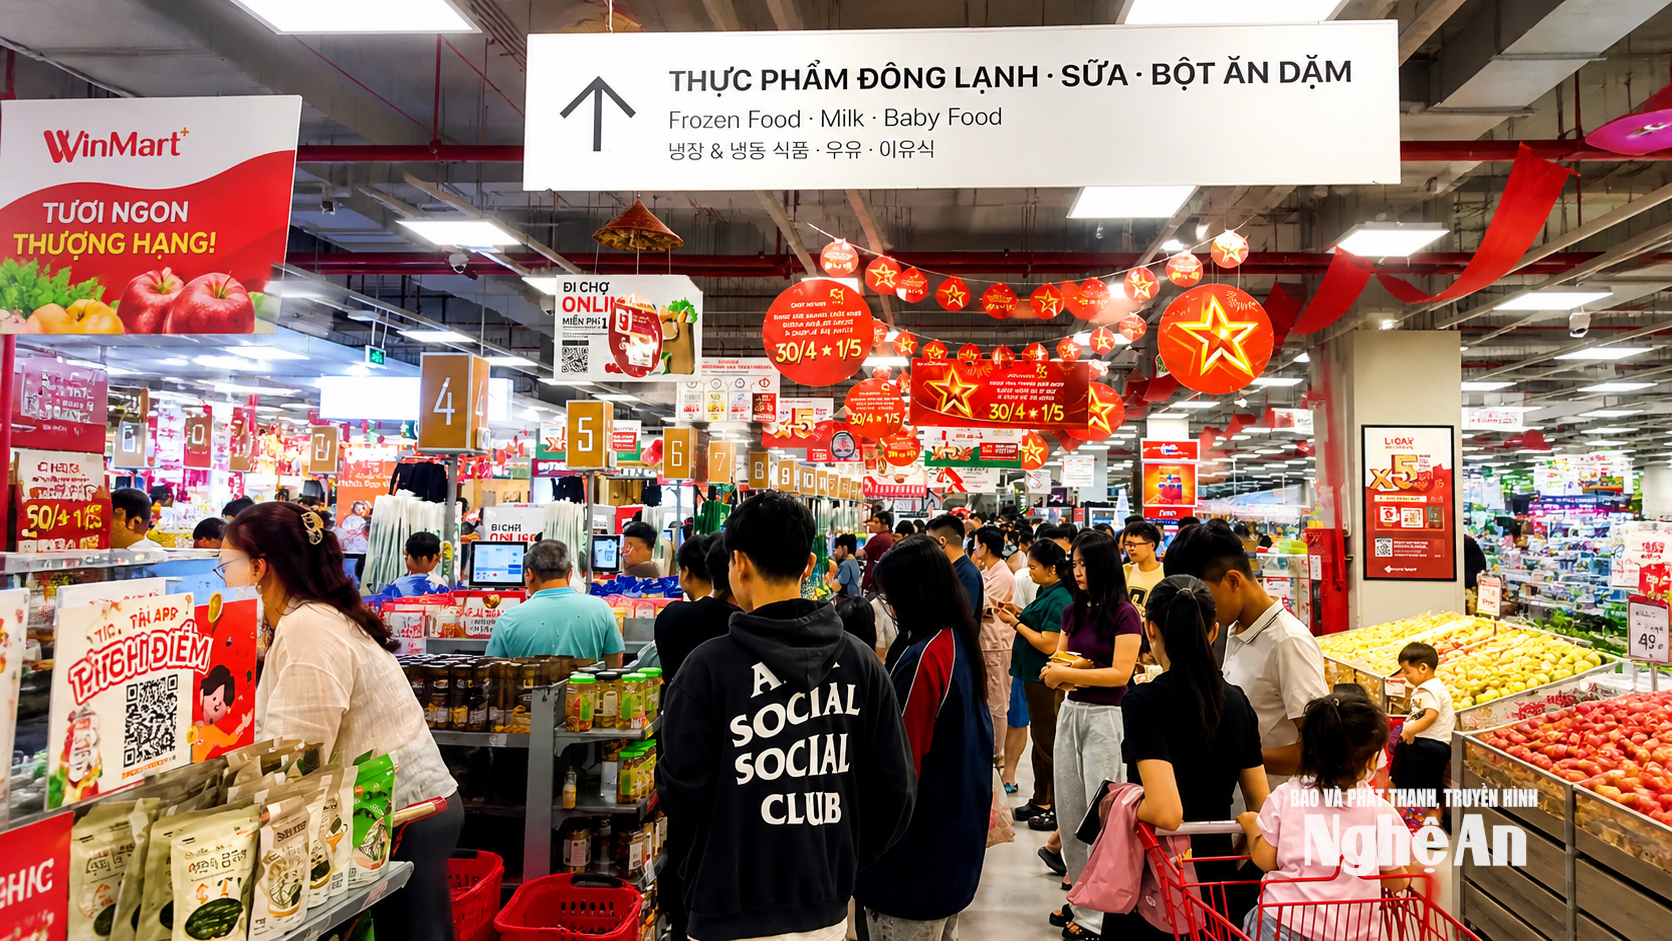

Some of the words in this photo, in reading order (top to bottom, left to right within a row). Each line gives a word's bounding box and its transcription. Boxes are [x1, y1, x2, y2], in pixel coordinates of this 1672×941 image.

[669, 66, 752, 97] THỰC
[761, 59, 848, 90] PHẨM
[857, 62, 946, 90] ĐÔNG
[955, 65, 1038, 94] LẠNH
[1061, 58, 1129, 87] SỮA
[1151, 56, 1216, 91] BỘT
[1224, 55, 1269, 85] ĂN
[1280, 54, 1352, 90] DẶM
[669, 111, 740, 129] Frozen
[749, 109, 801, 129] Food
[821, 109, 864, 127] Milk
[884, 108, 941, 131] Baby
[949, 107, 1002, 126] Food
[669, 142, 704, 161] 냉장
[710, 142, 724, 159] &
[730, 142, 767, 160] 냉동
[773, 141, 809, 160] 식품
[826, 141, 862, 159] 우유
[879, 140, 934, 159] 이유식
[43, 199, 104, 224] TƯƠI
[111, 201, 189, 223] NGON
[13, 230, 126, 261] THƯỢNG
[132, 231, 217, 260] HẠNG!
[563, 282, 576, 293] ĐI
[579, 281, 610, 295] CHỢ
[562, 296, 615, 313] ONLI
[775, 340, 817, 364] 30/4
[836, 339, 862, 360] 1/5
[433, 377, 456, 425] 4
[989, 402, 1026, 422] 30/4
[1042, 402, 1064, 422] 1/5
[577, 416, 593, 452] 5
[671, 440, 683, 467] 6
[714, 452, 726, 472] 7
[781, 467, 790, 485] 9
[729, 682, 861, 748] SOCIAL
[734, 733, 850, 786] SOCIAL
[760, 791, 842, 826] CLUB
